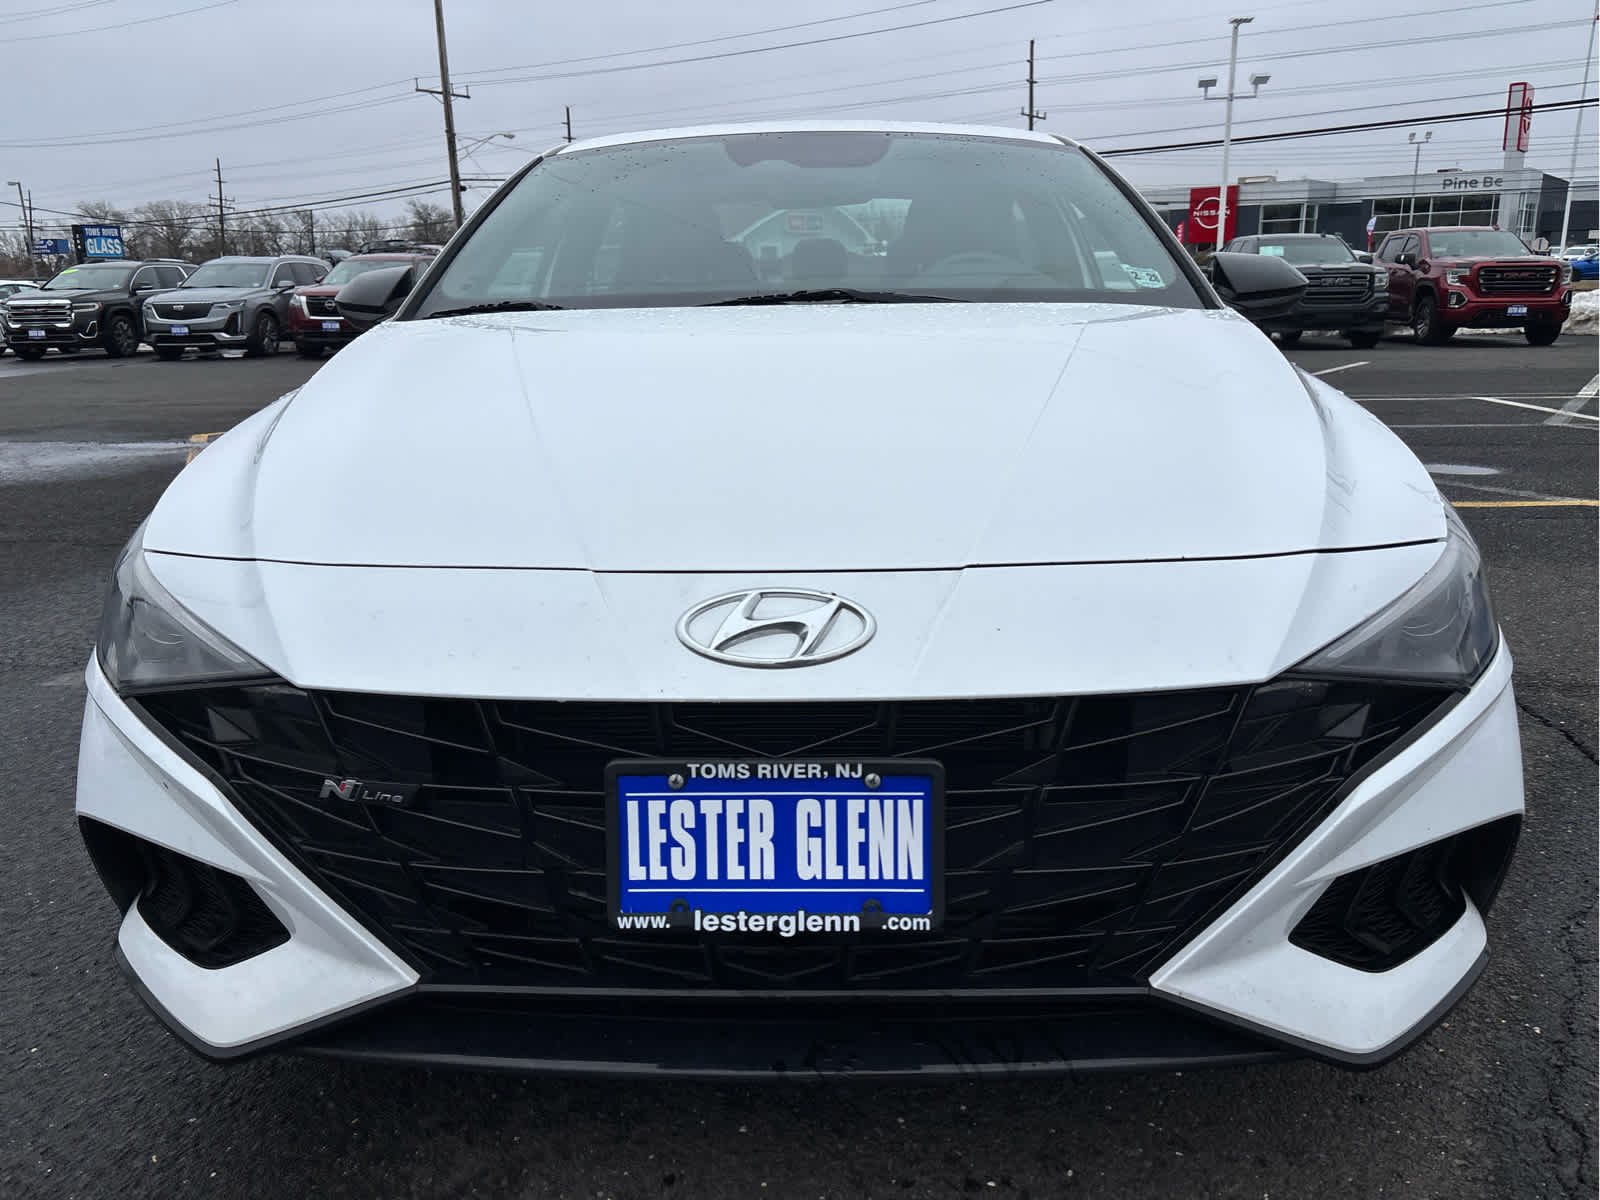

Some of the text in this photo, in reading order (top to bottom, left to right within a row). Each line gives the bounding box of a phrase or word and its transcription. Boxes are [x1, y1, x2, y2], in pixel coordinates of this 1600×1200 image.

[1442, 177, 1479, 190] Pine
[1193, 208, 1231, 217] NISSN
[87, 238, 121, 255] GLASS
[687, 763, 863, 780] TOMS RIVER, NJ
[362, 790, 403, 802] Line
[626, 798, 925, 881] LESTER GLENN
[617, 909, 931, 938] www. lesterglenn .com
